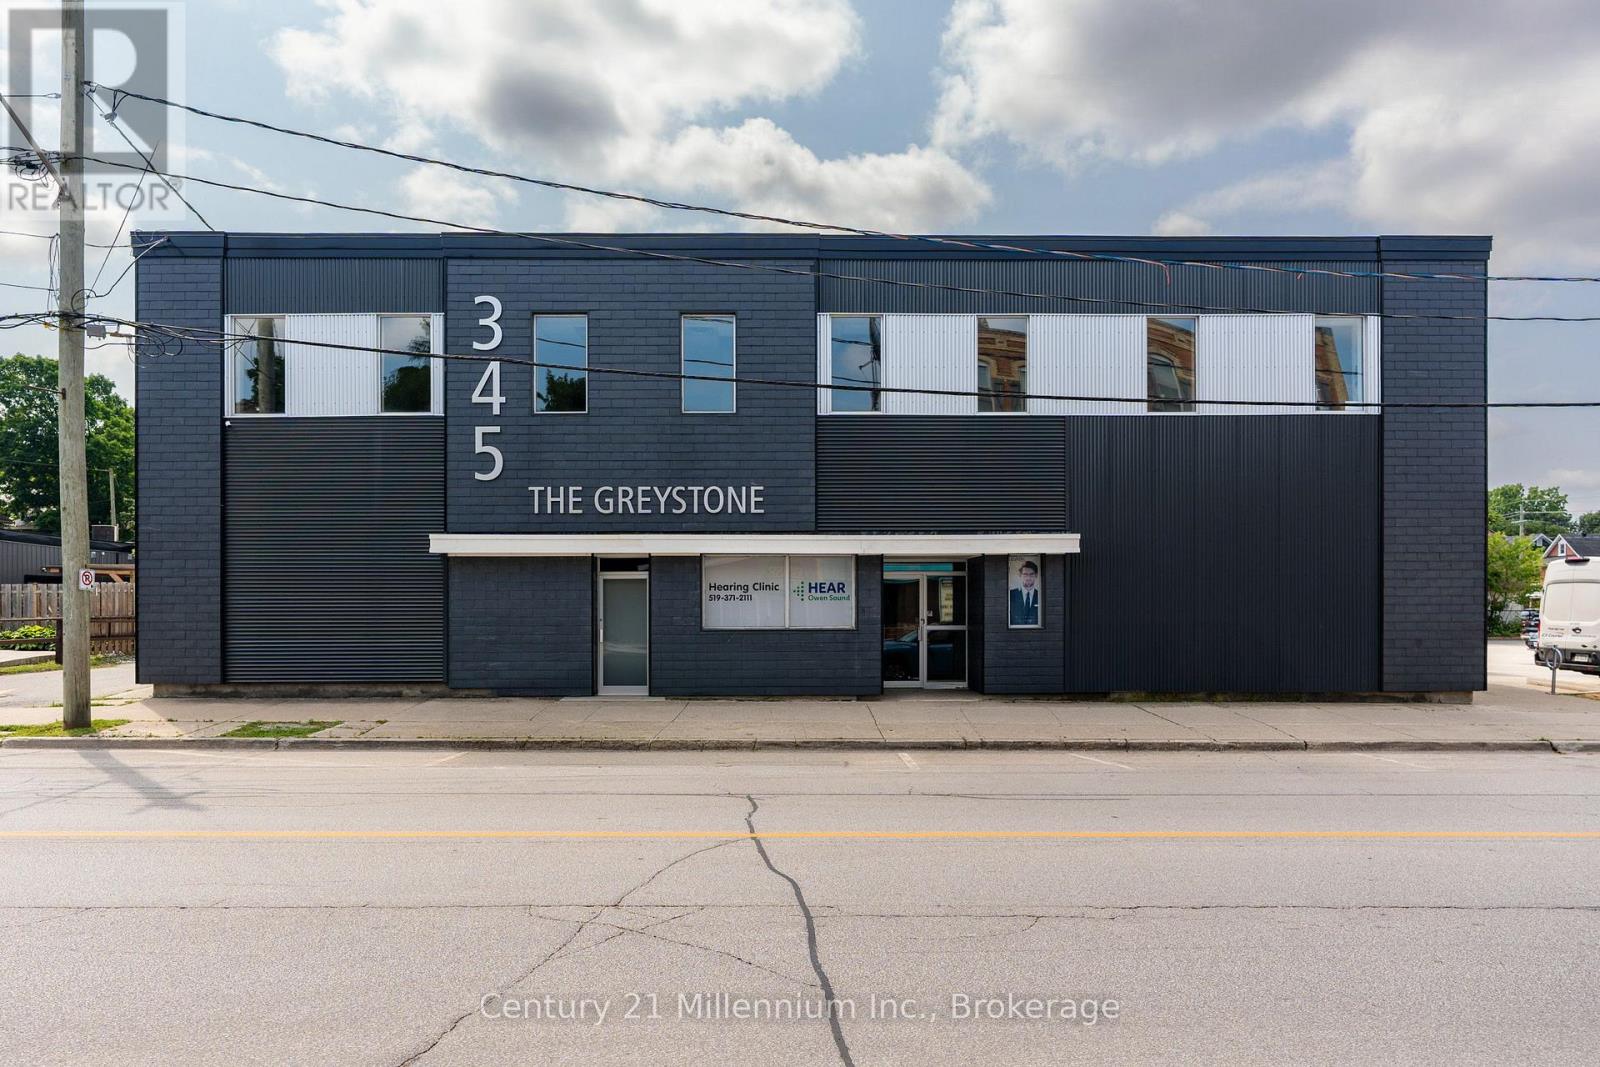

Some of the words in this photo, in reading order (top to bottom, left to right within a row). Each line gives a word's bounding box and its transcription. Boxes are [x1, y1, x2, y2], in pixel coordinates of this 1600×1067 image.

[528, 486, 583, 514] THE
[593, 485, 765, 514] GREYSTONE
[708, 582, 749, 593] Hearing
[752, 582, 780, 591] Clinic
[808, 582, 846, 593] HEAR
[708, 594, 752, 602] 519-371-2111
